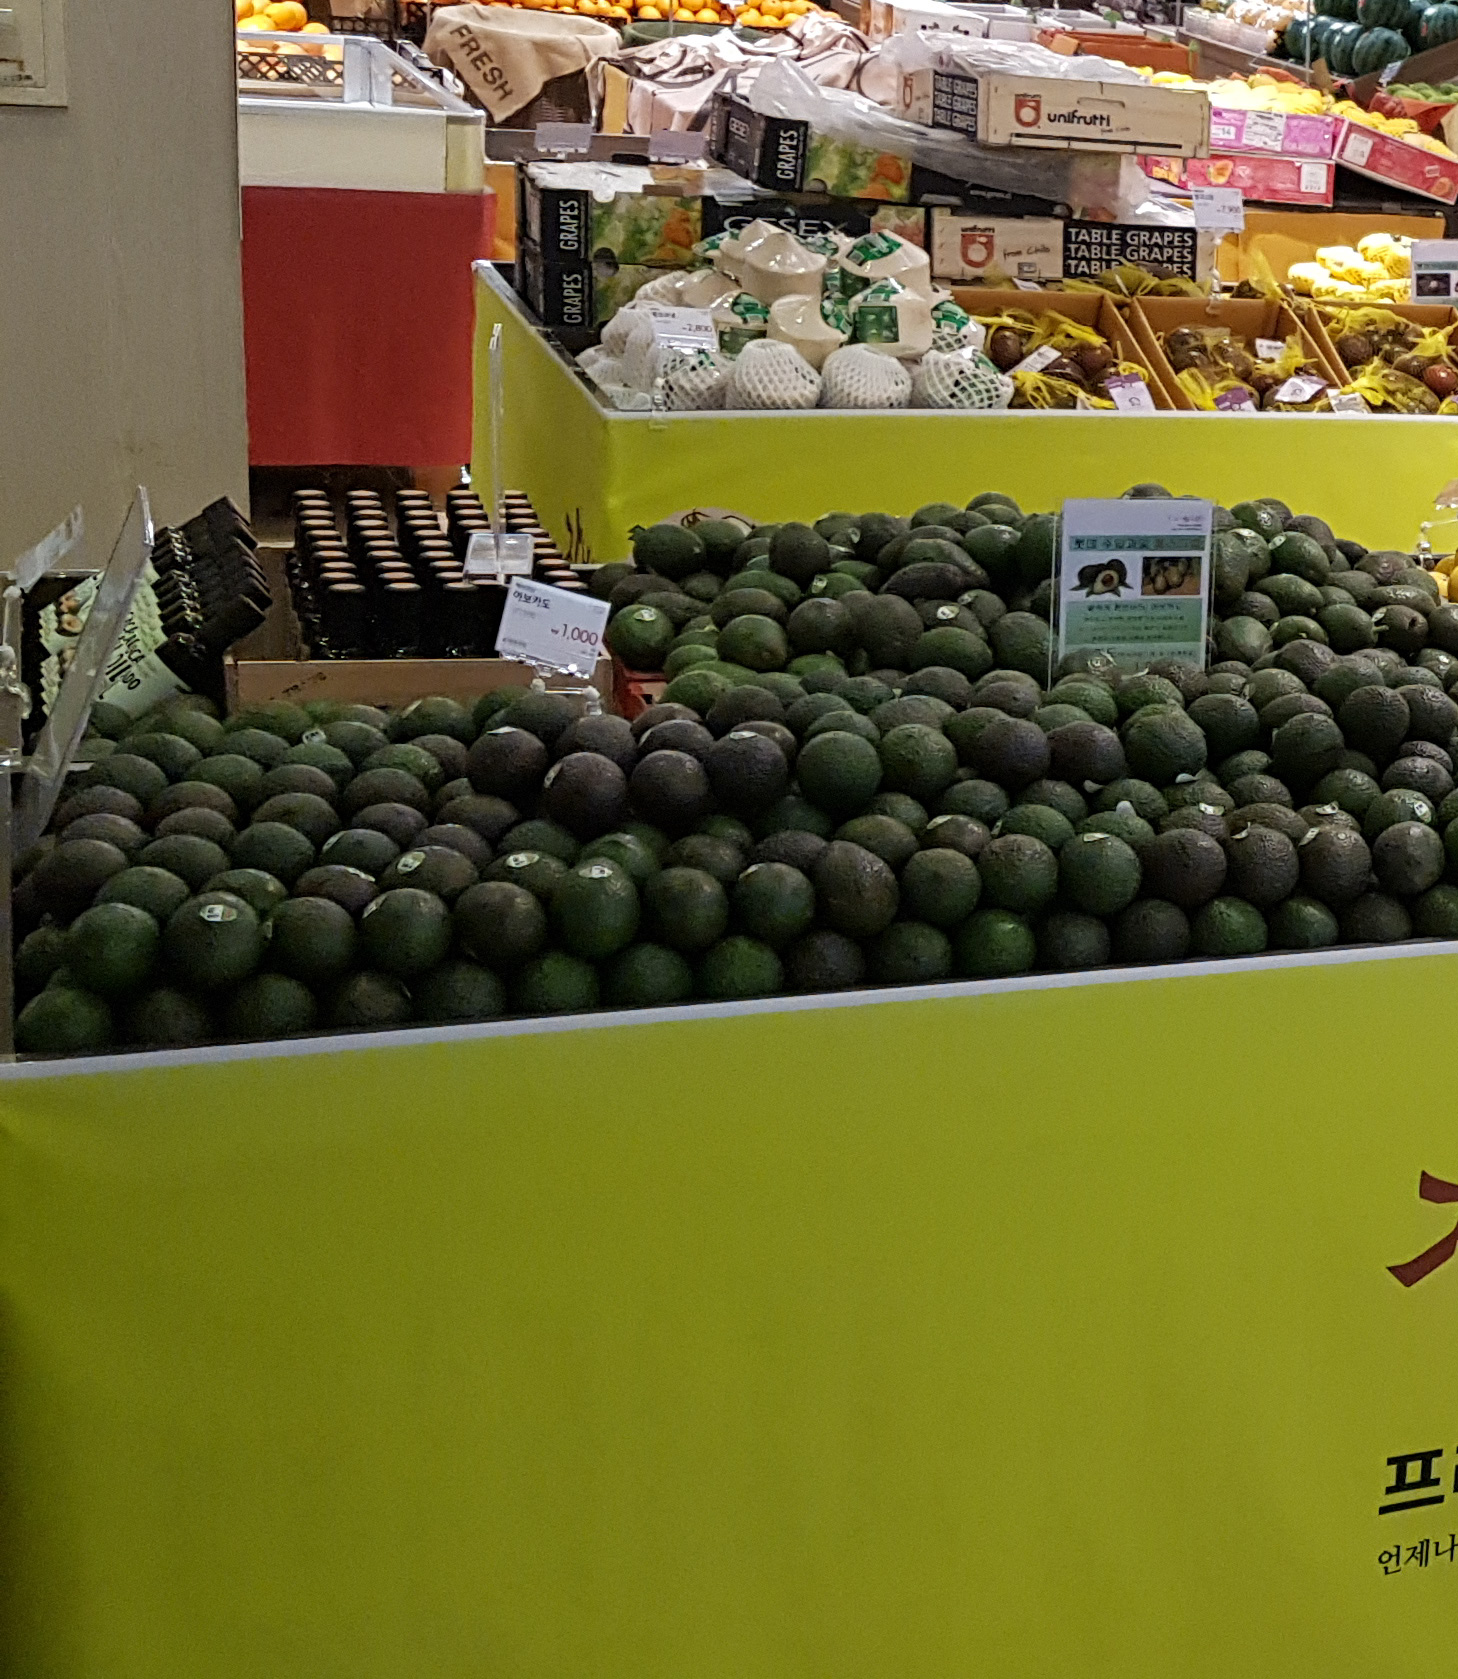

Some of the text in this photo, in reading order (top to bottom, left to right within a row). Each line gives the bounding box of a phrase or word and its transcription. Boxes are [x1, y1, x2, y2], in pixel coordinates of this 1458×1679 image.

[449, 24, 514, 102] FRESH
[1047, 109, 1111, 128] unifrutti
[777, 129, 798, 180] GRAPES
[559, 200, 579, 251] GRAPES
[1067, 227, 1193, 247] TABLE GRAPES
[1067, 243, 1193, 262] TABLE GRAPES
[563, 273, 582, 324] GRAPES
